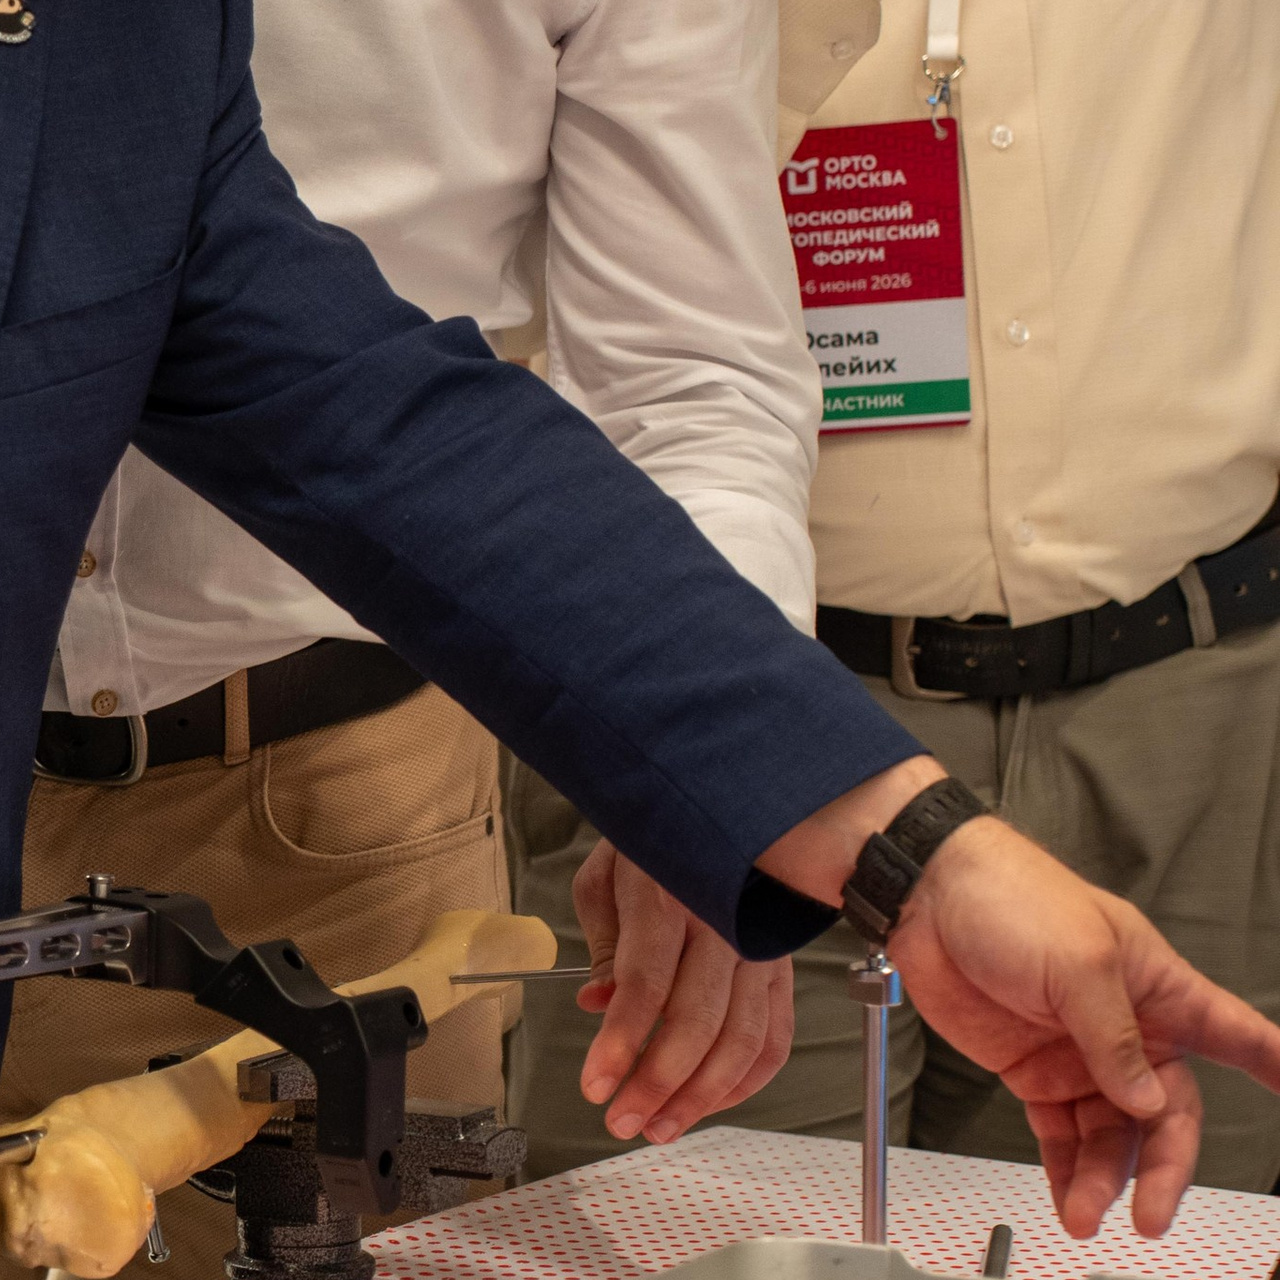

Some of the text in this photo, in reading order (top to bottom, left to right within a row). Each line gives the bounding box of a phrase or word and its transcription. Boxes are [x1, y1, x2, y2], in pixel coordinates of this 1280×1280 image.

[823, 154, 877, 174] ОРТО
[825, 169, 907, 191] МОСКВА
[790, 219, 940, 248] ОПЕДИЧЕСКИЙ
[812, 247, 885, 267] ФОРУМ
[820, 278, 867, 294] июня
[870, 272, 913, 291] 2026
[823, 393, 905, 412] ЧАСТНИК
